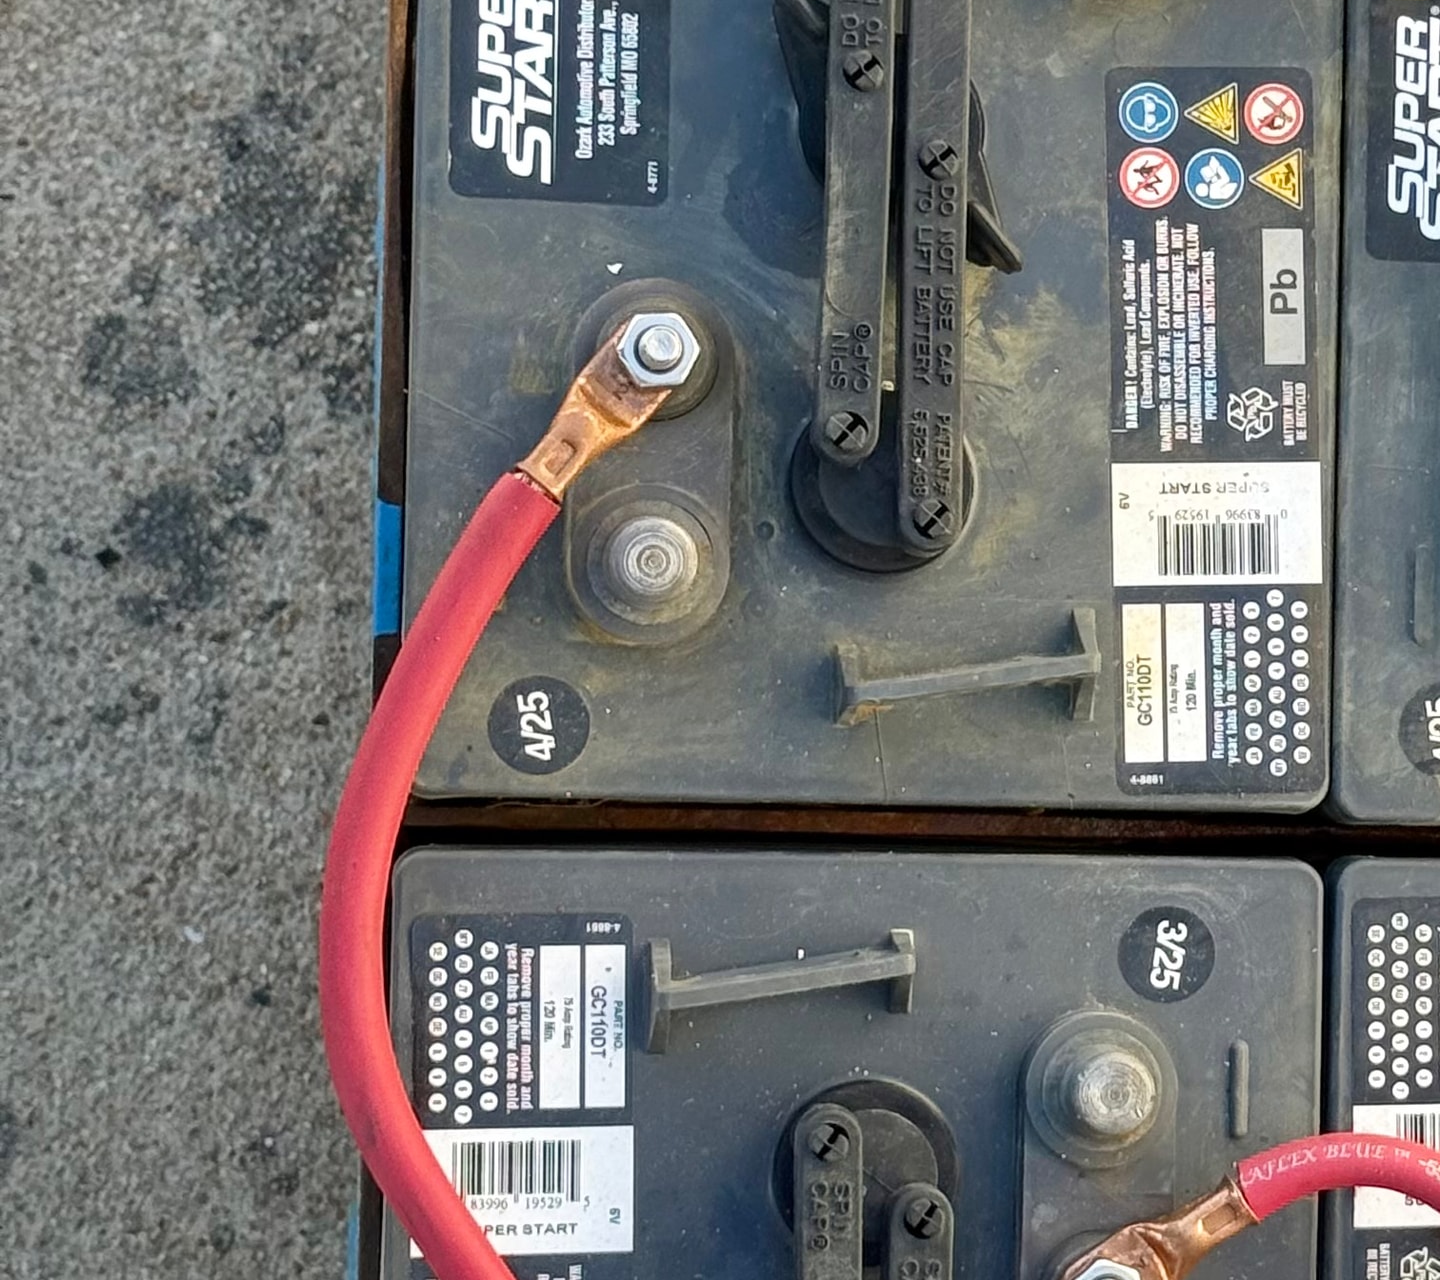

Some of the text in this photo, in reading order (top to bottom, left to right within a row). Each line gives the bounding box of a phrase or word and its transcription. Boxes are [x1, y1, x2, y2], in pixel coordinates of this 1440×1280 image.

[842, 15, 860, 46] DO
[866, 17, 882, 46] TO
[598, 33, 618, 87] Patterson
[620, 13, 641, 135] Springfield MO 65802
[575, 62, 595, 125] Automotive
[597, 89, 617, 122] South
[1387, 16, 1428, 220] SUPER
[575, 127, 594, 160] Ozark
[597, 124, 616, 146] 233
[1269, 269, 1298, 315] Pb
[829, 331, 850, 391] SPIN
[1119, 492, 1131, 511] 6V
[1159, 482, 1212, 495] START
[1223, 631, 1237, 658] date
[1125, 657, 1137, 708] PART NO.
[1136, 654, 1153, 726] GC110DT
[1209, 603, 1227, 759] Remove proper month and
[1224, 660, 1237, 692] show
[1185, 693, 1197, 712] 120
[1225, 694, 1238, 707] to
[516, 690, 557, 762] 4/25
[1225, 709, 1238, 735] tabs
[1227, 736, 1242, 765] year
[1149, 920, 1189, 991] 3/25
[544, 999, 556, 1019] 120
[591, 985, 608, 1059] GC110DT
[613, 1000, 624, 1052] PART NO.
[522, 1223, 578, 1236] START
[609, 1208, 621, 1225] 6V
